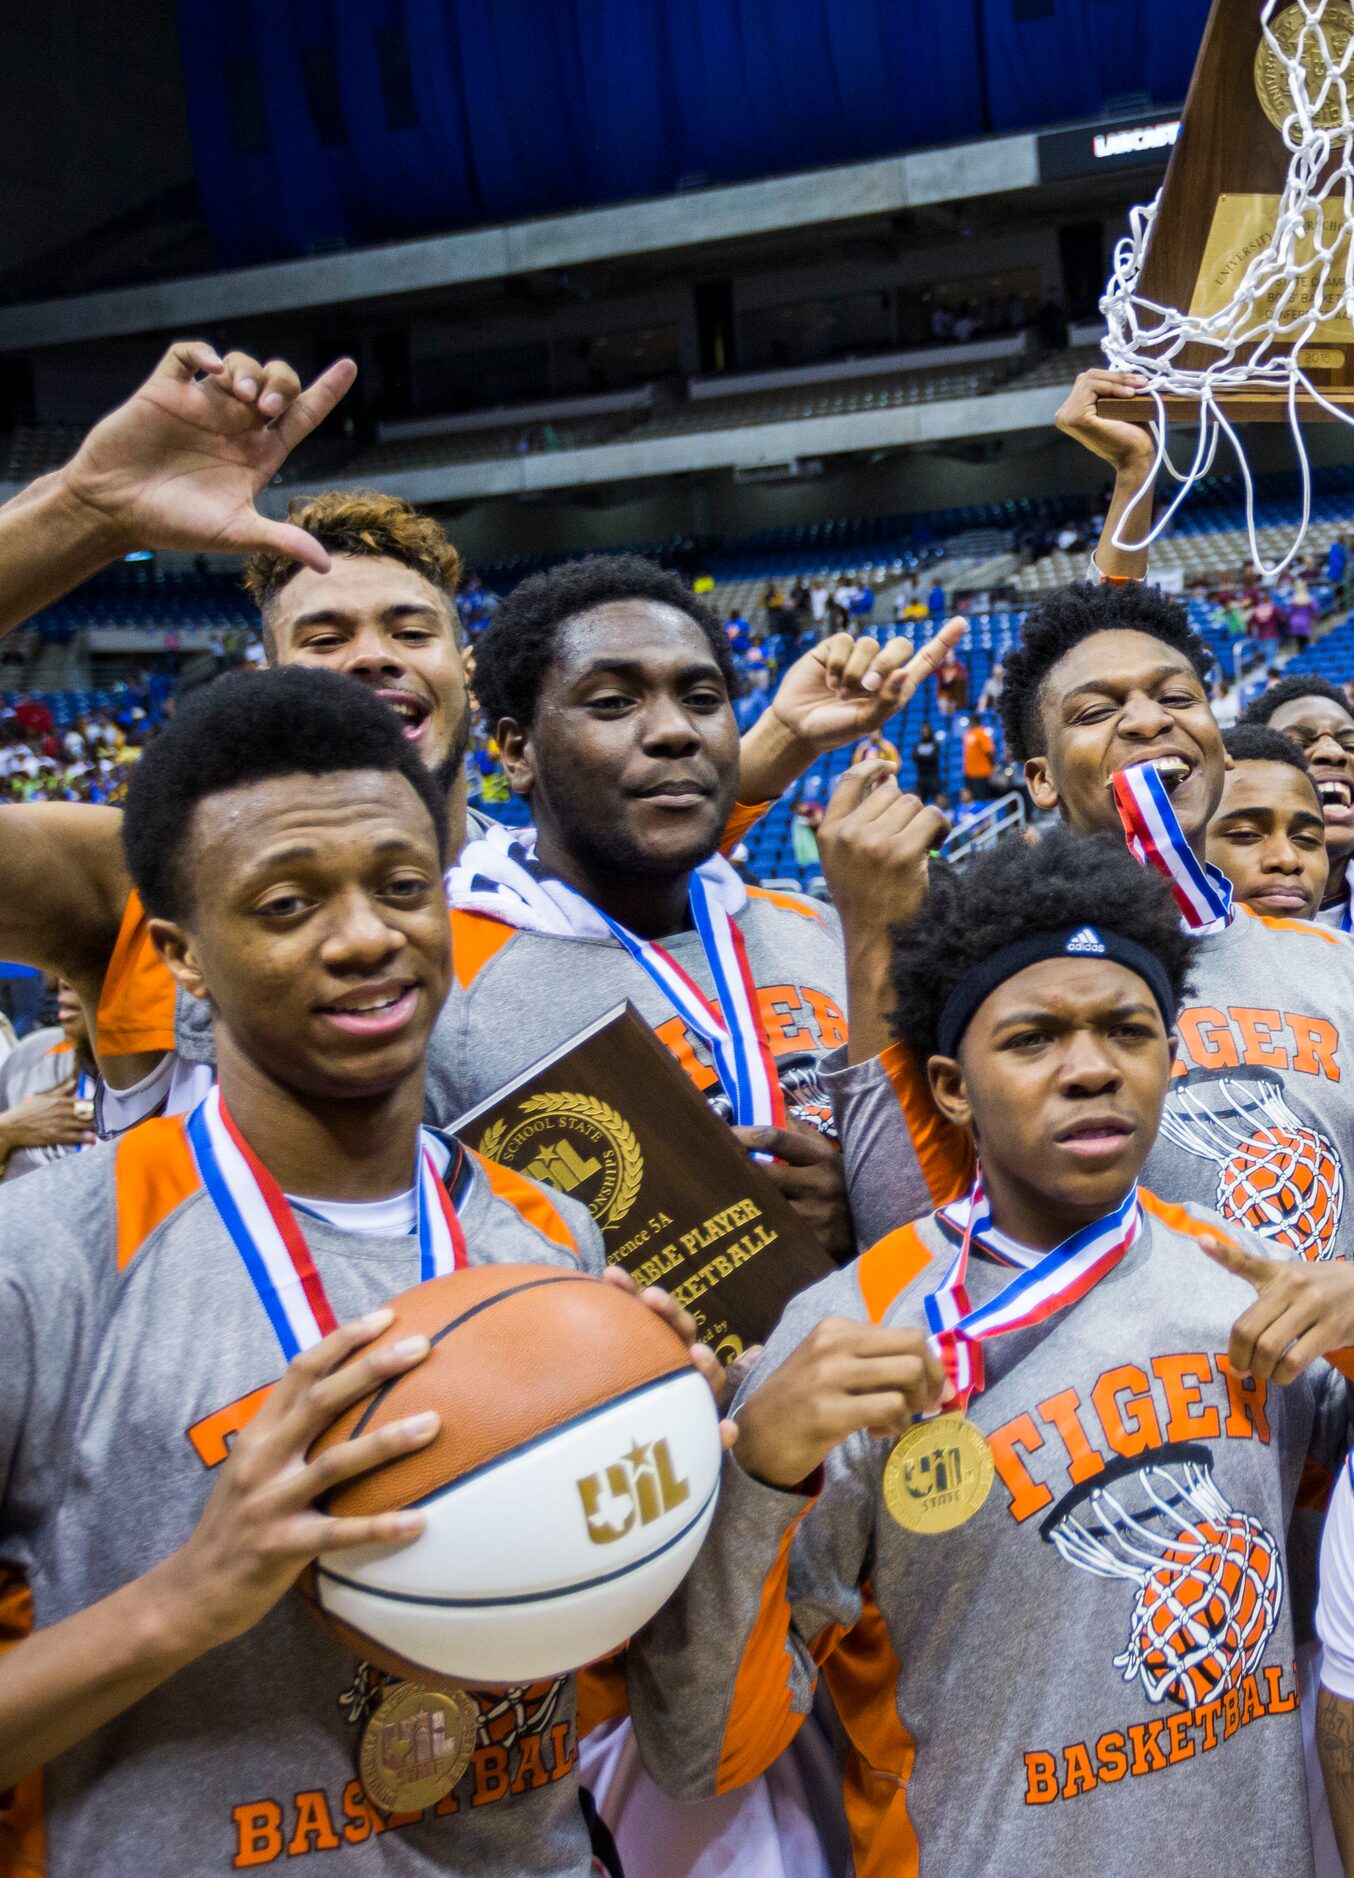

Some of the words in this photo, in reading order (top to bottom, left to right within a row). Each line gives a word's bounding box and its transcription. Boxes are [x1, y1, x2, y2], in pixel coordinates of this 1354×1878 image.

[1304, 352, 1331, 364] 2015
[503, 1118, 555, 1162] SCHOOL
[559, 1116, 604, 1143] STATE
[648, 1211, 674, 1235] 5A
[679, 1198, 763, 1256] PLAYER
[986, 1352, 1271, 1525] TIGER
